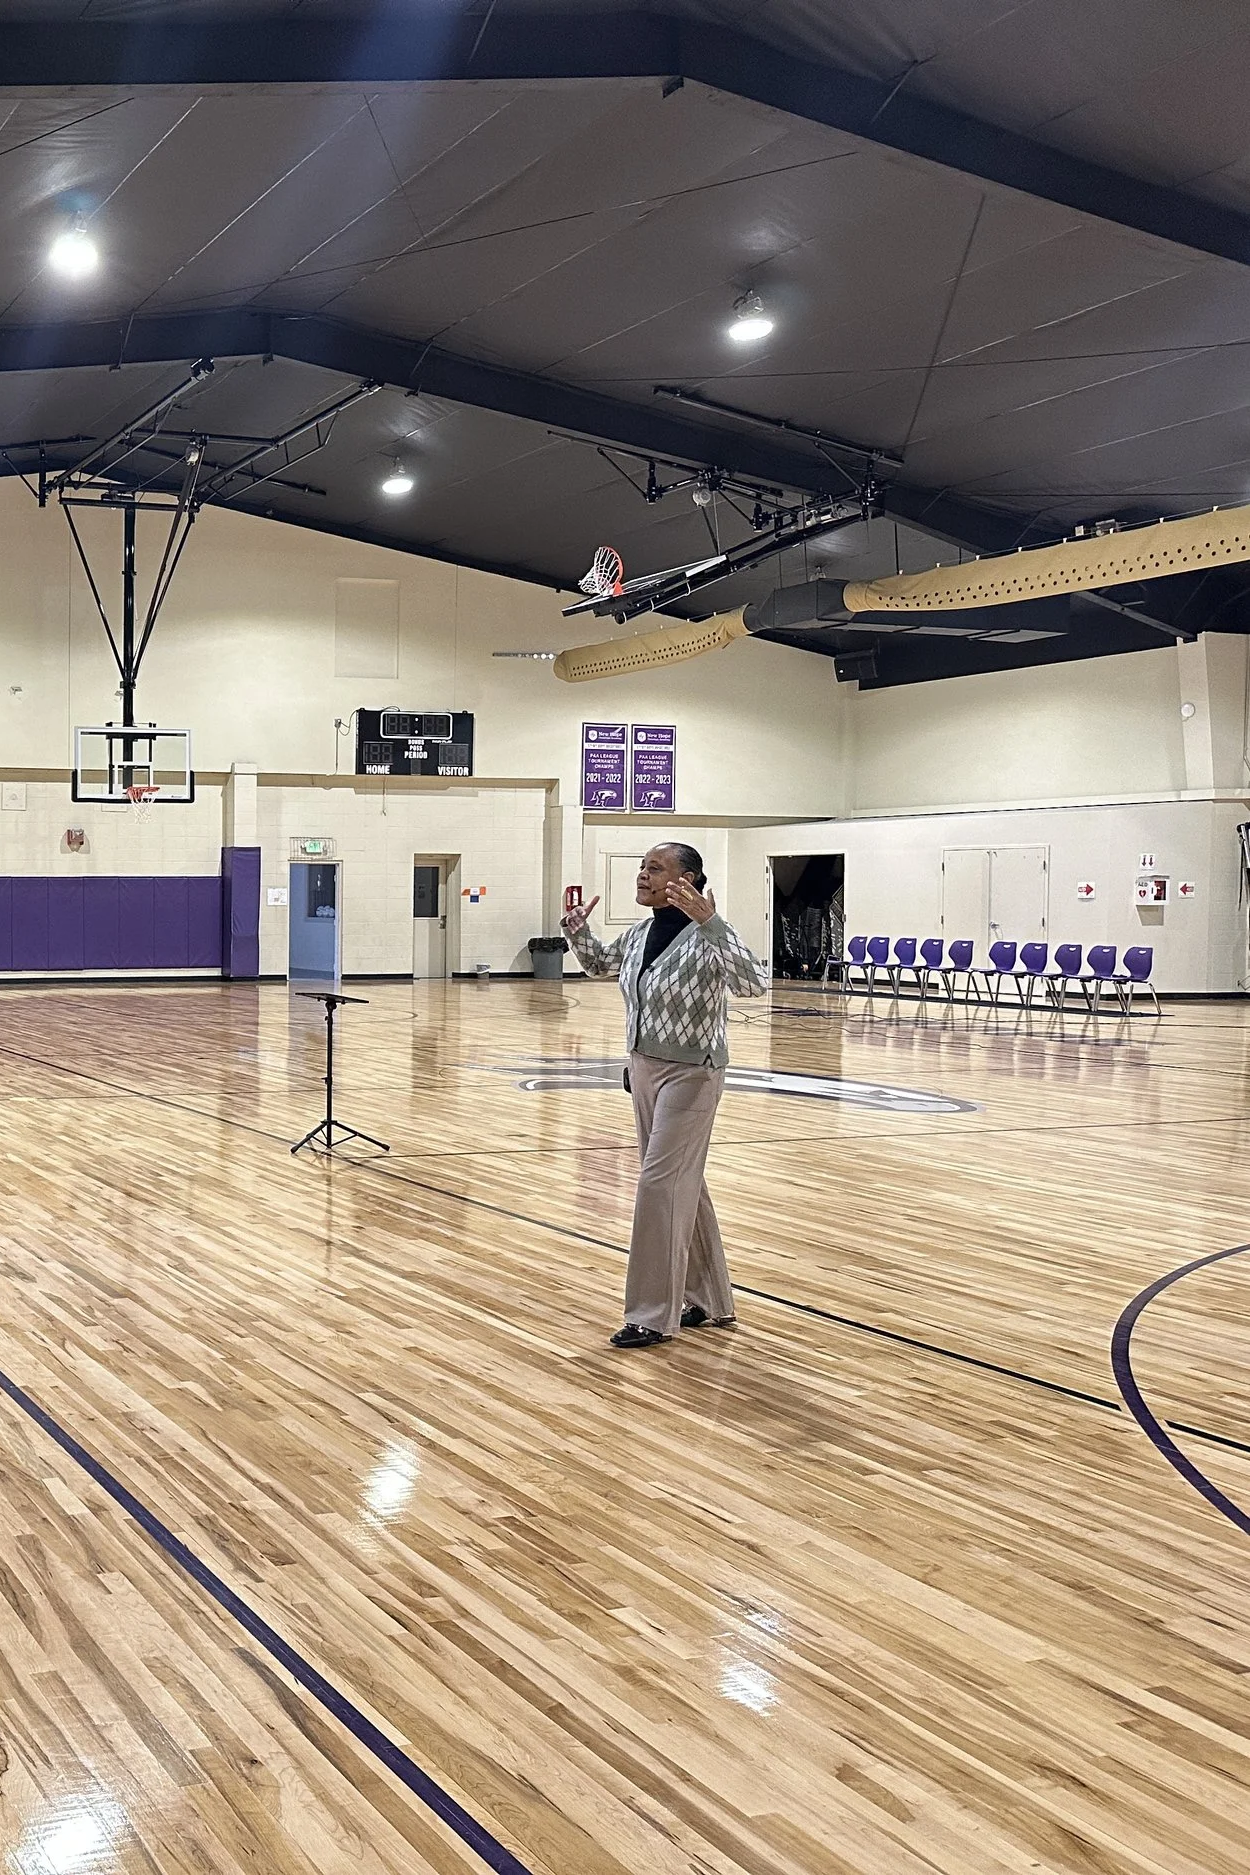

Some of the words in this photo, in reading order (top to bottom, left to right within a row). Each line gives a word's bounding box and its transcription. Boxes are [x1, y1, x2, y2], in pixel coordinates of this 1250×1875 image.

[404, 751, 428, 759] PERIOD
[366, 765, 390, 774] HOME
[437, 766, 469, 776] VISITOR
[586, 773, 601, 783] 2021
[606, 773, 621, 783] 2022
[635, 774, 650, 784] 2022
[656, 774, 671, 784] 2023
